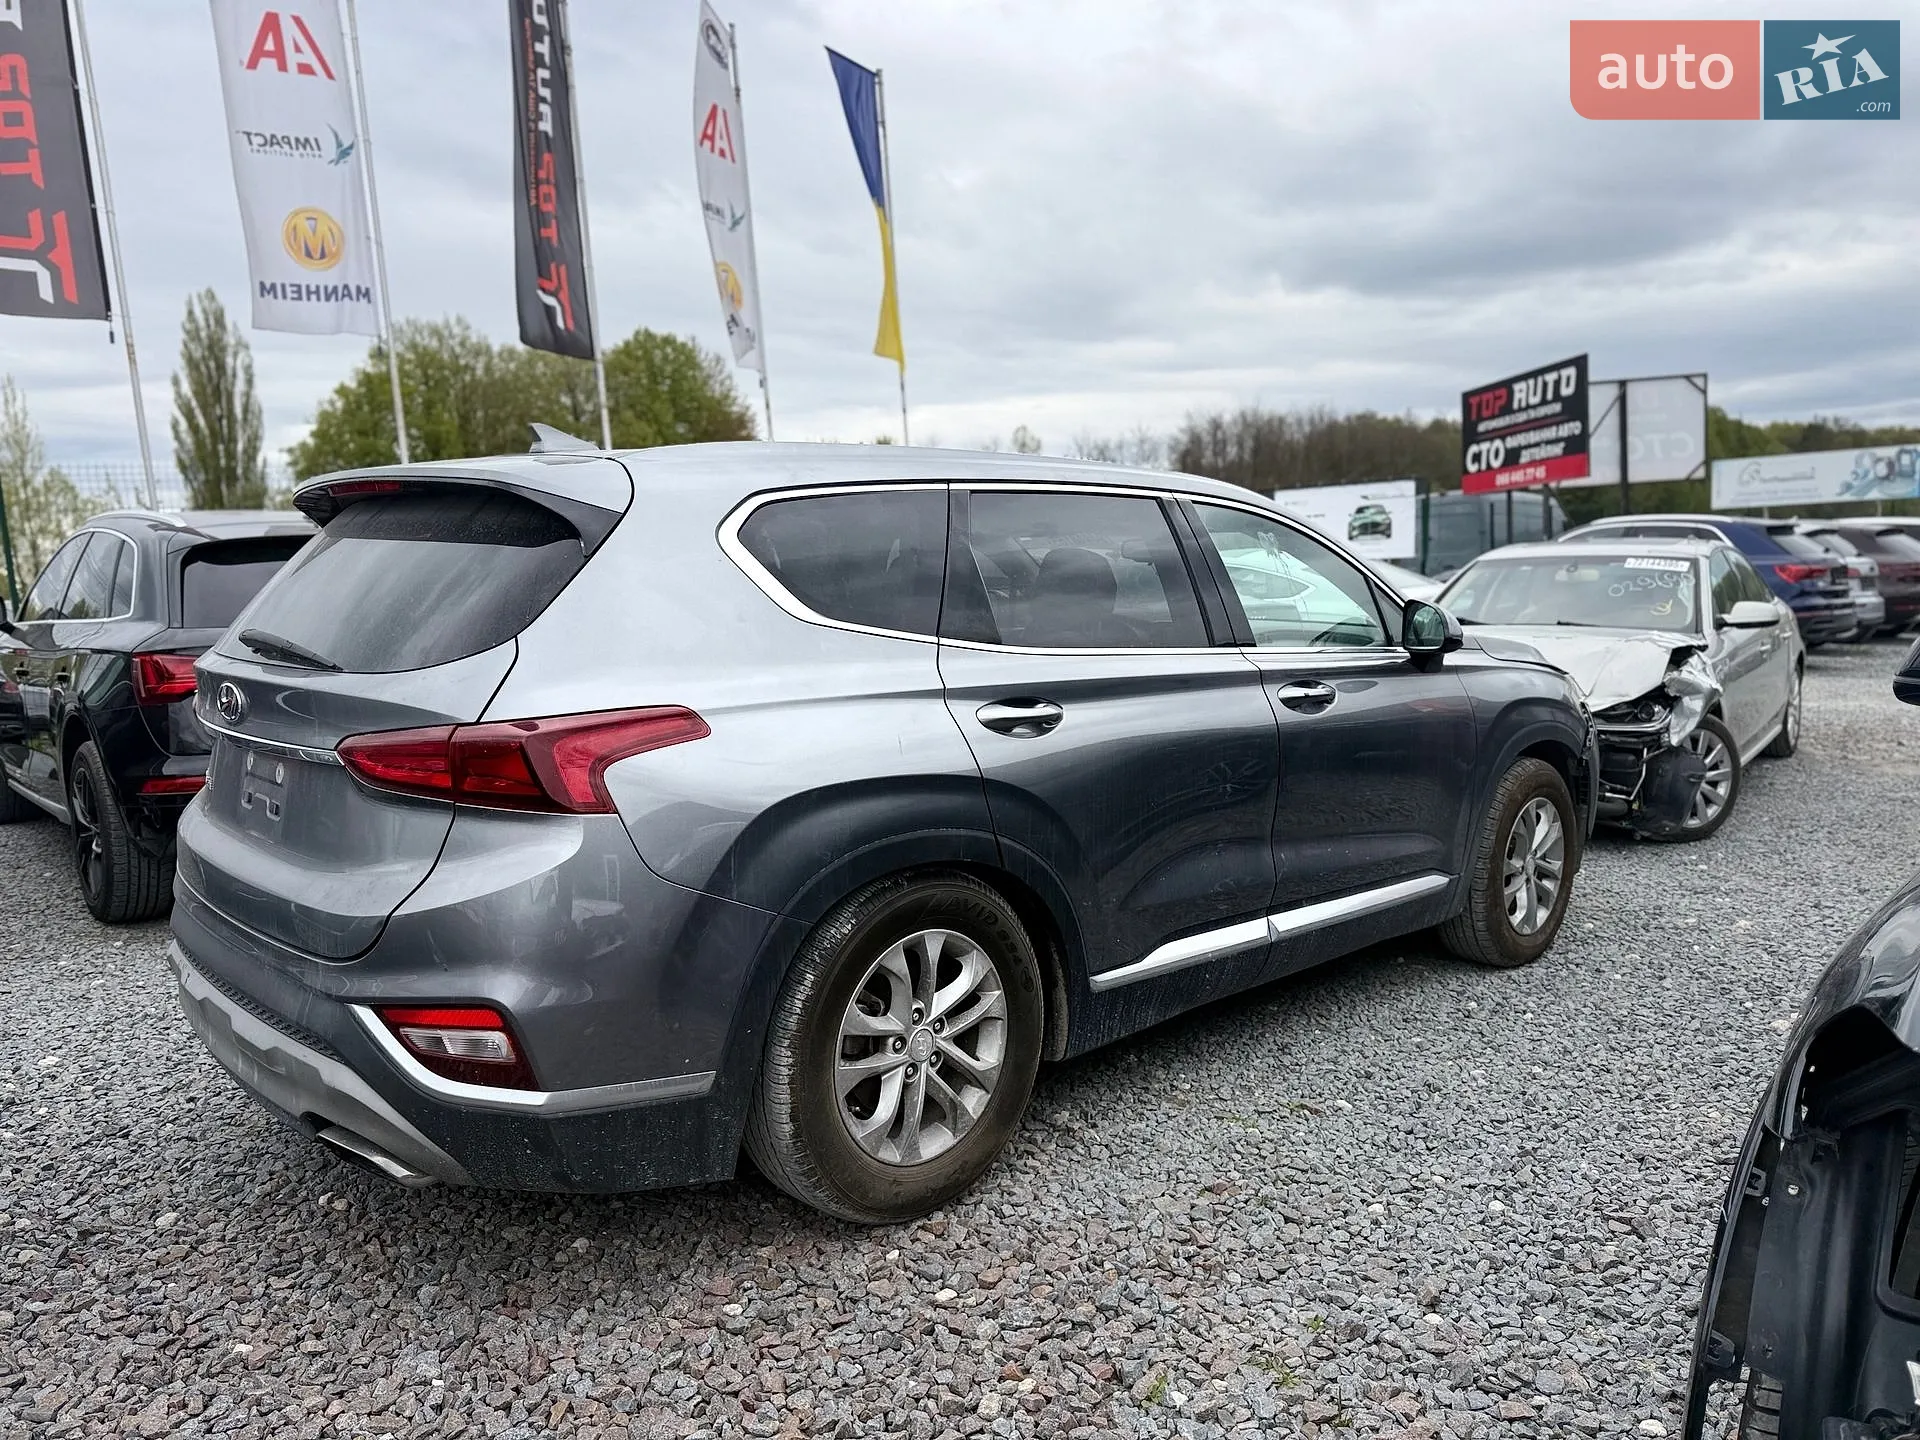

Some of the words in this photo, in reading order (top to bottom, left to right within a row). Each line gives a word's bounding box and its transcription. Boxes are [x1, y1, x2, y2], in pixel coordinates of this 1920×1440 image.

[1468, 387, 1508, 421] TOP
[1512, 366, 1577, 411] AUTO
[1465, 438, 1505, 474] СТО
